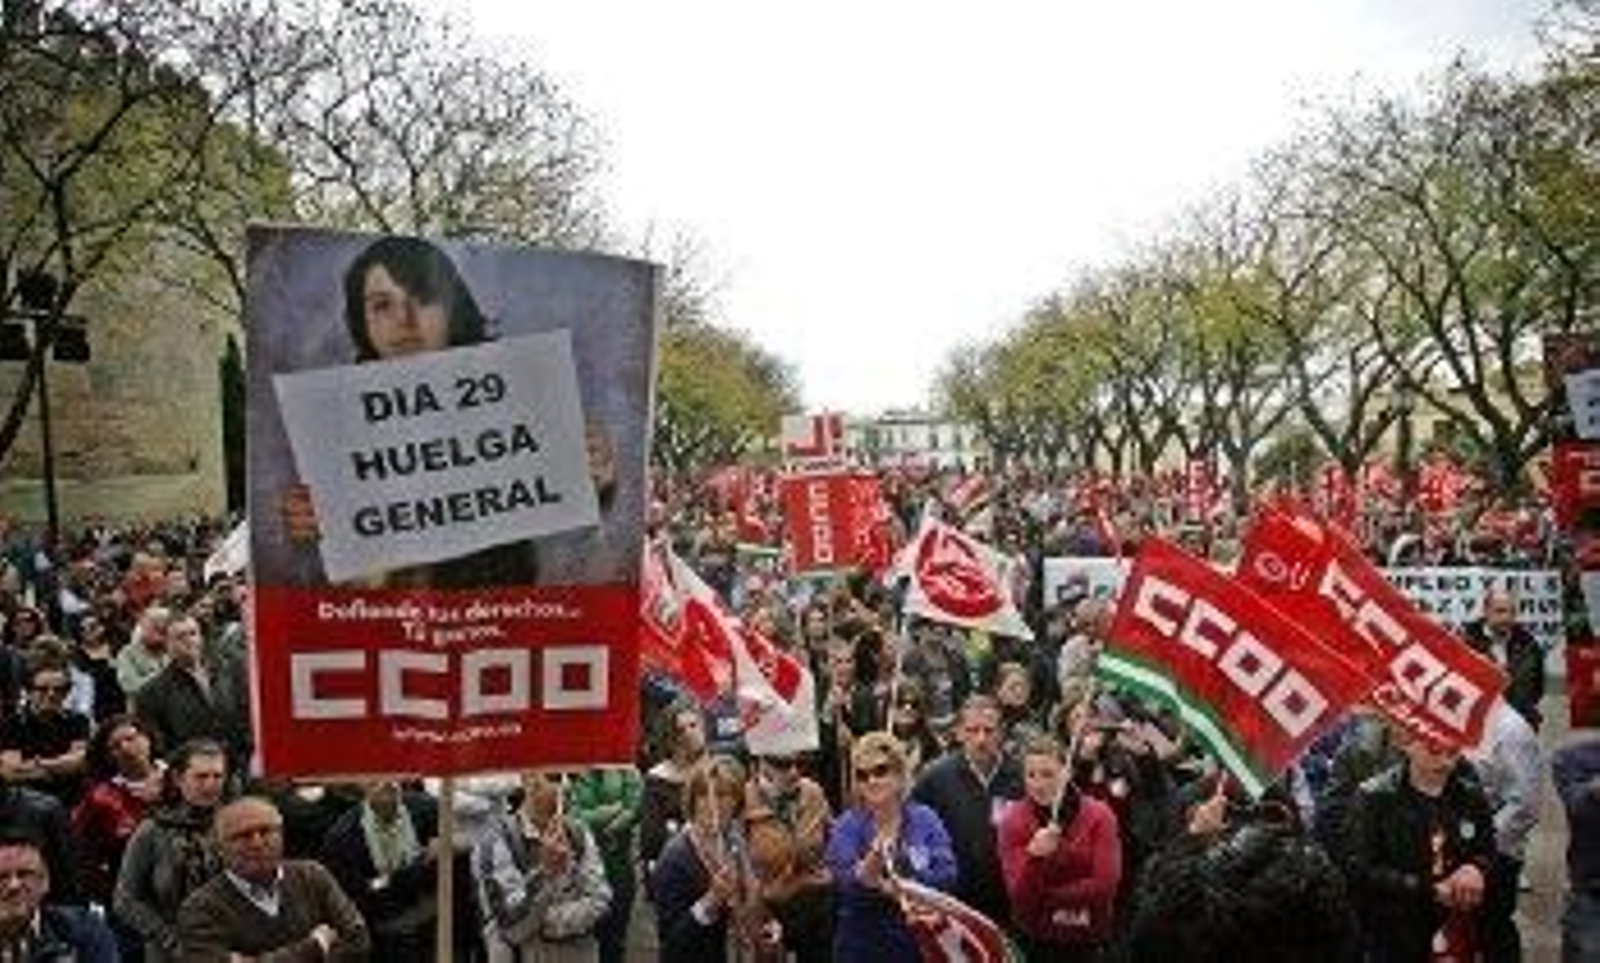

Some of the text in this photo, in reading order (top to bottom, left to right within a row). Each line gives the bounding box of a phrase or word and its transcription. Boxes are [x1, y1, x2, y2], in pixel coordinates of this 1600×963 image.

[361, 373, 506, 422] DIA 29
[351, 424, 540, 482] HUELGA
[354, 475, 562, 538] GENERAL
[1134, 576, 1329, 738] CCOO
[1318, 558, 1484, 732] CCOO
[290, 644, 610, 720] CCOO
